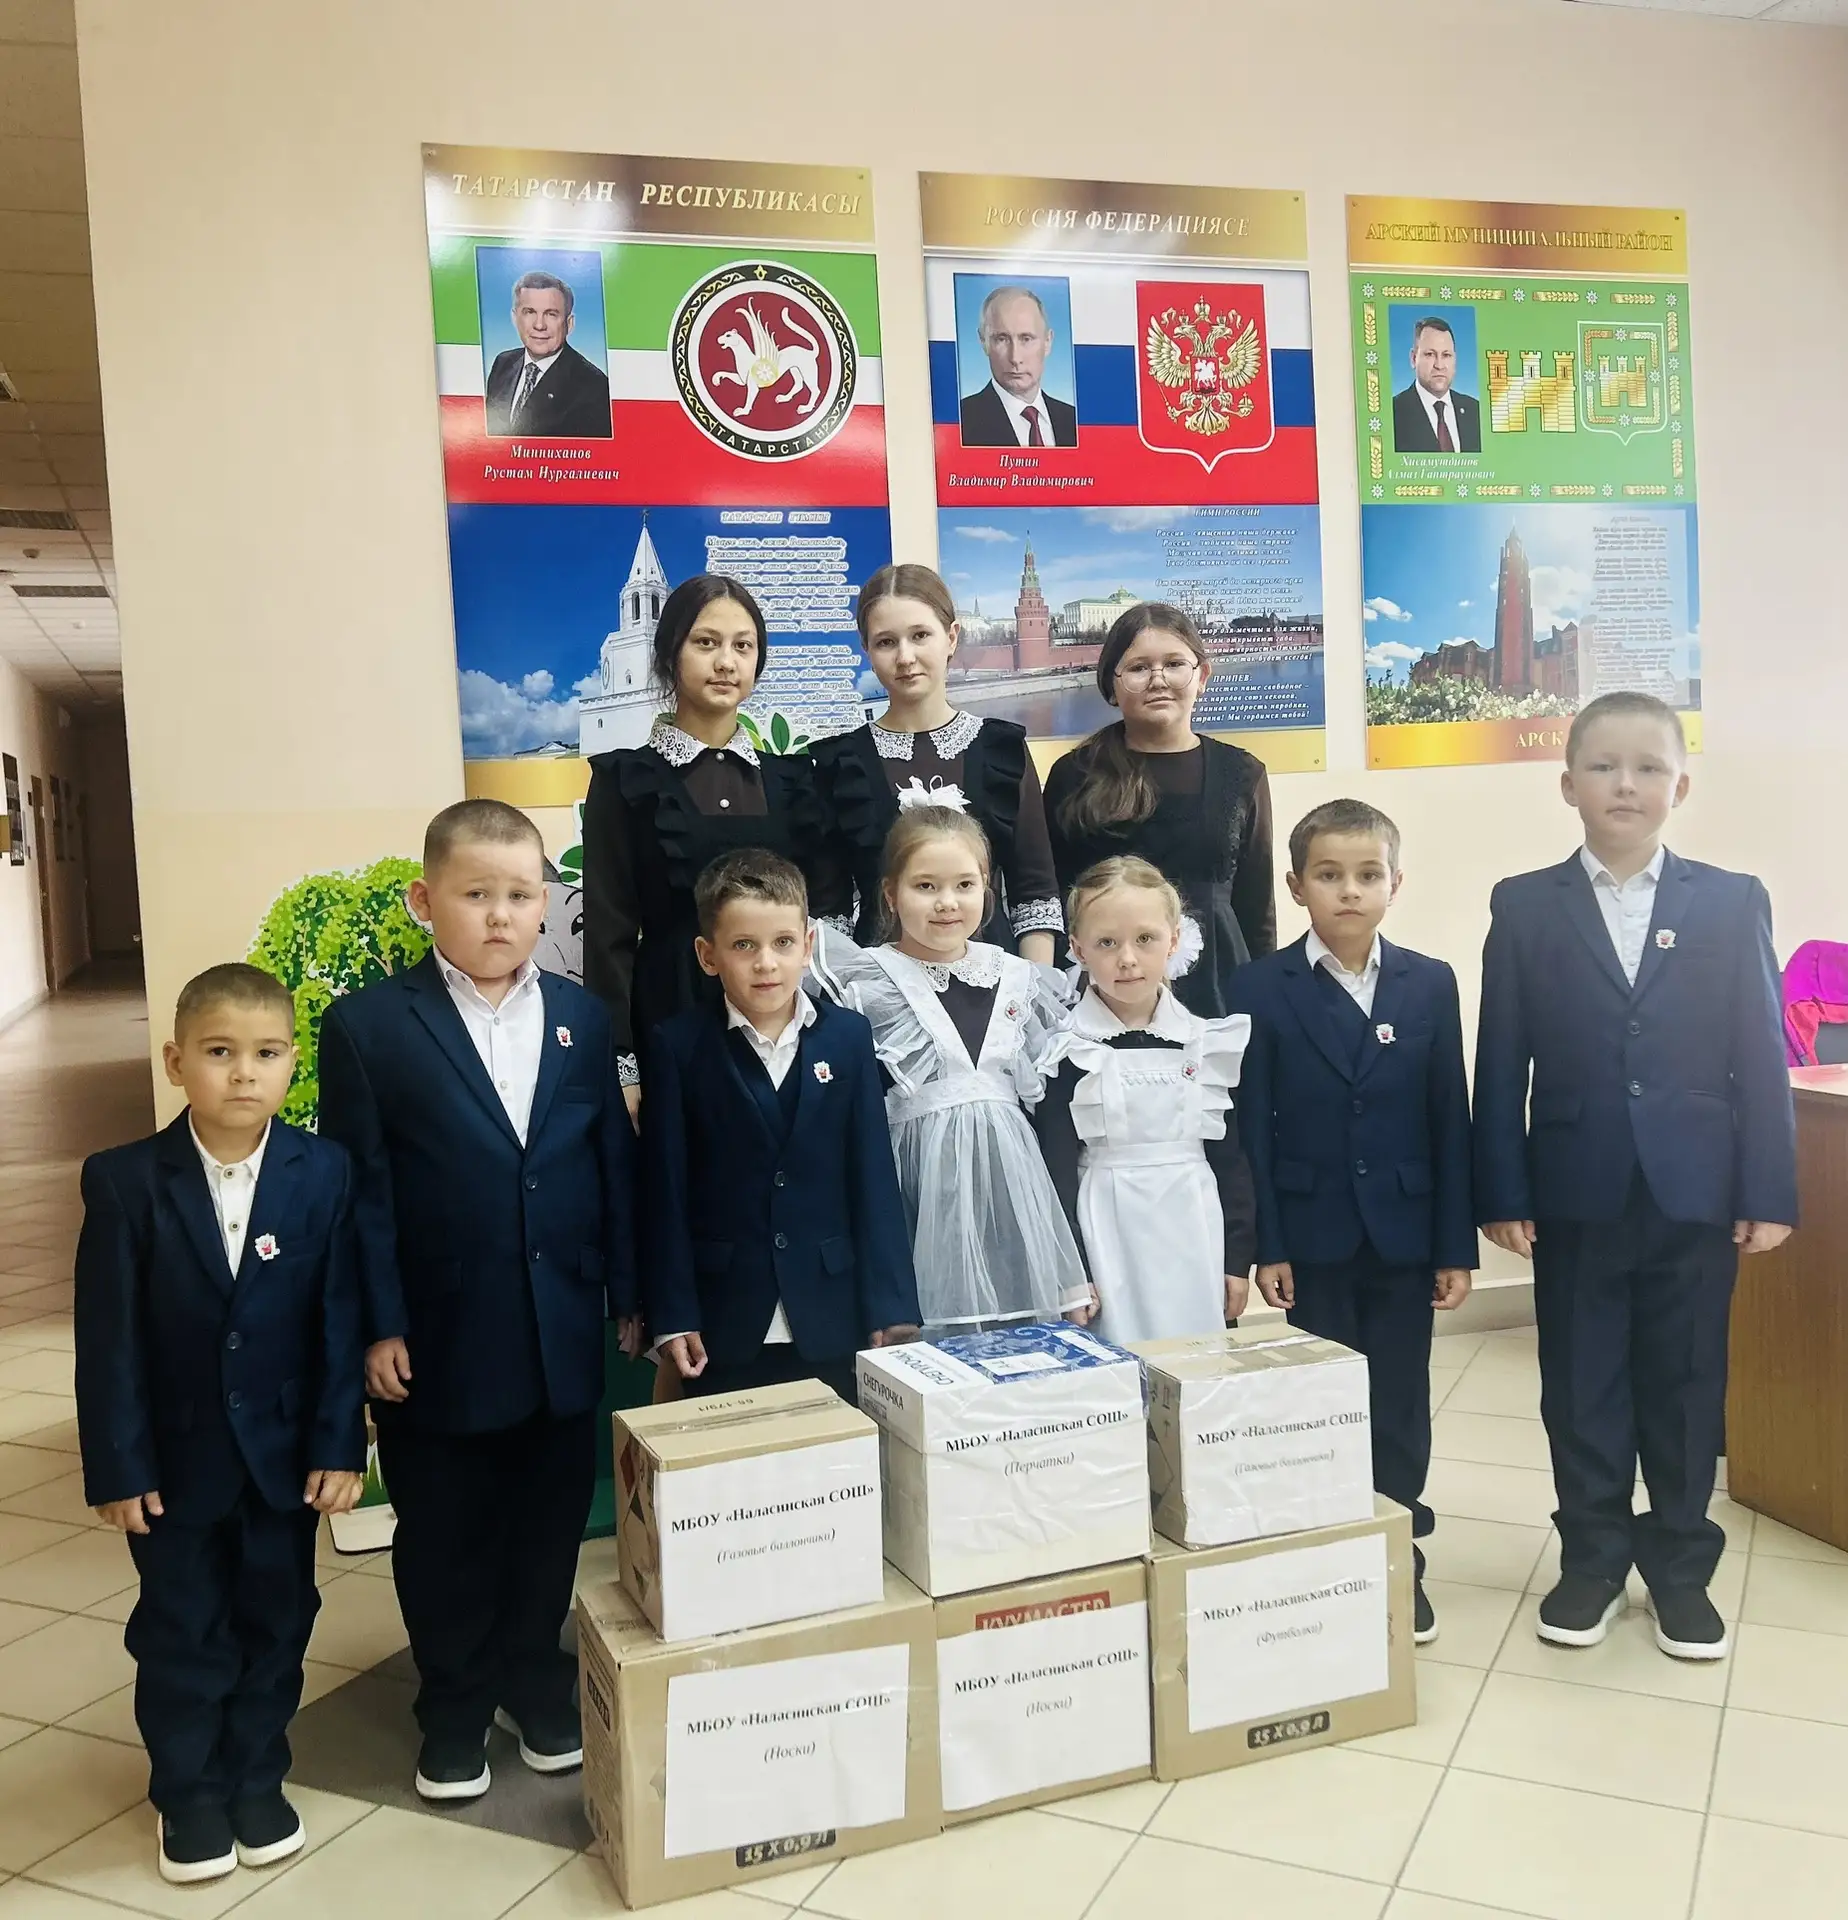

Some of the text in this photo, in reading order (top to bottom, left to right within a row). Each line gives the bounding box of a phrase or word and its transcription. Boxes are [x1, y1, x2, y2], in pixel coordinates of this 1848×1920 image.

[451, 173, 861, 216] ТАТАРСТАН РЕСПУБЛИКАСЫ
[983, 206, 1252, 237] РОССИЯ ФЕДЕРАЦИЯСЕ
[1365, 221, 1674, 252] АРСКИЙ МУНИЦИПАЛЬНЫЙ РАЙОН
[509, 443, 593, 461] Минниханов
[716, 425, 825, 455] ТАТАРСТАН
[483, 463, 621, 484] Рустам Нургалиевич
[998, 453, 1041, 471] Путин
[947, 473, 1096, 490] Владимир Владимирович
[1223, 508, 1261, 517] РОССИИ
[1205, 682, 1303, 693] ечество наше свободное
[1212, 674, 1254, 683] ПРИПЕВ:
[1199, 704, 1228, 713] данная
[1229, 703, 1269, 714] мудрость
[1209, 694, 1243, 704] народов
[1244, 694, 1263, 702] союз
[1191, 709, 1311, 724] страна! Мы гордимся тобой!
[1514, 730, 1564, 749] АРСК
[863, 1371, 905, 1411] СНЕГУРОЧКА
[945, 1410, 1130, 1453] МБОУ «Наласинская СОШ»
[1196, 1411, 1370, 1447] МБОУ «Наласинская СОШ»
[1003, 1451, 1076, 1477] (Перчатки)
[670, 1484, 875, 1534] МБОУ «Наласинская СОШ»
[716, 1527, 837, 1564] (Газовые баллончики)
[1202, 1604, 1245, 1623] МБОУ
[1247, 1588, 1333, 1614] «Наласинская
[953, 1648, 1140, 1695] МБОУ «Наласинская СОШ»
[686, 1693, 892, 1736] МБОУ «Наласинская СОШ»
[1024, 1695, 1074, 1718] (Носки)
[762, 1741, 817, 1764] (Носки)
